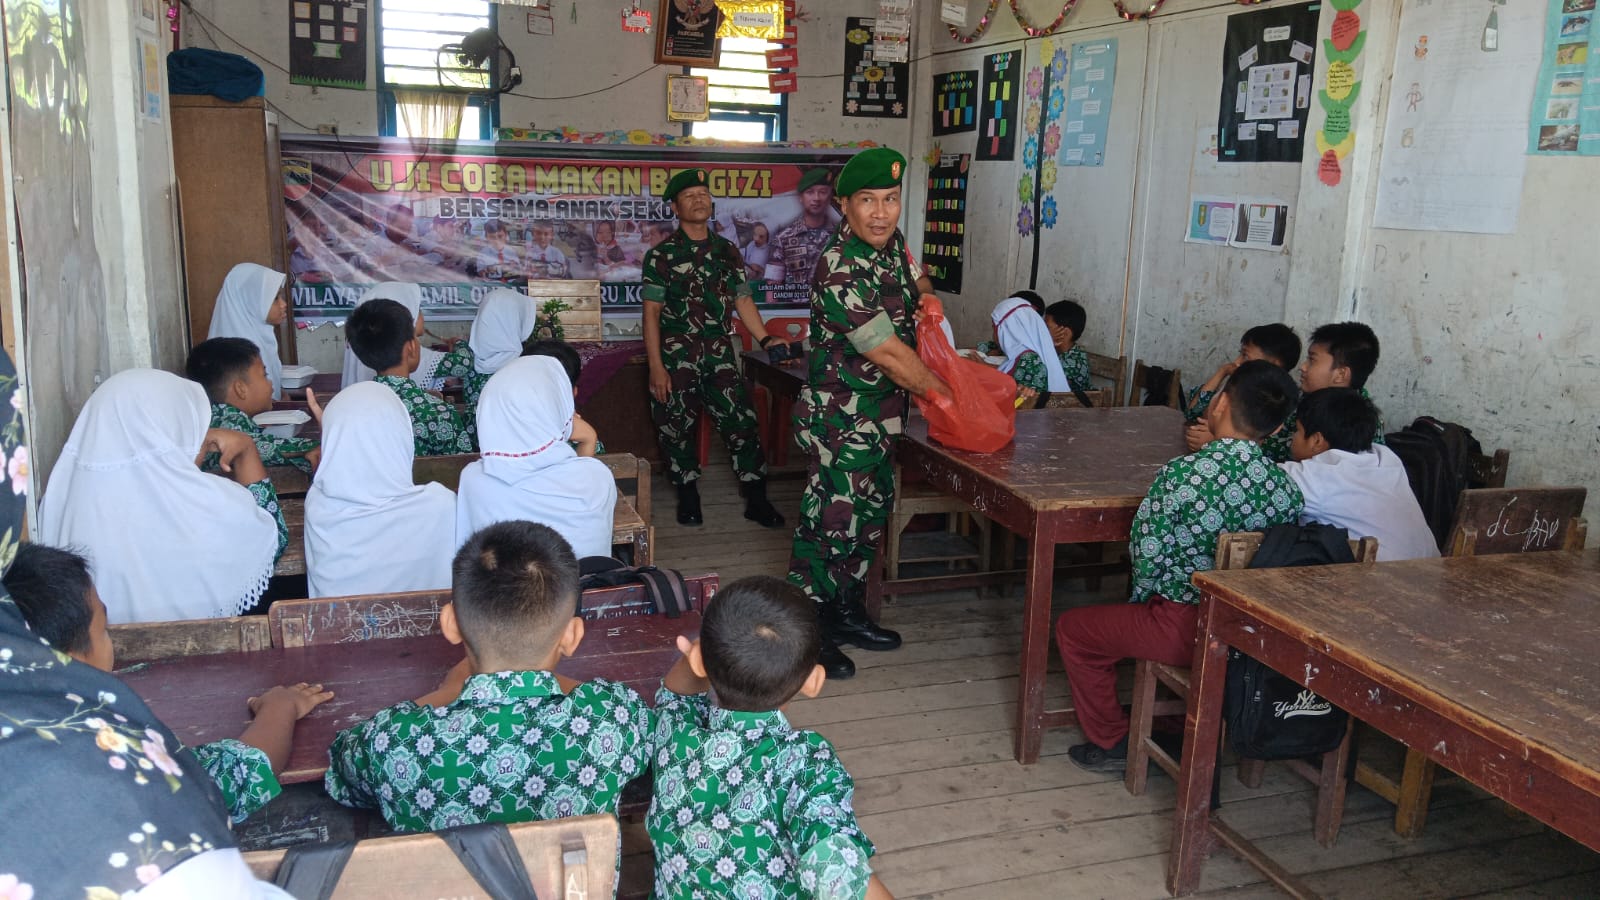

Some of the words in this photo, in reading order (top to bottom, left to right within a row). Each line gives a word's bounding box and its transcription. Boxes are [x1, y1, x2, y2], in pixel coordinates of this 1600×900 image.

[370, 160, 431, 192] UJI
[440, 162, 528, 194] COBA
[535, 164, 641, 196] MAKAN
[650, 167, 773, 198] BGIZI
[439, 198, 551, 219] BERSAMA
[555, 199, 615, 221] ANAK
[618, 200, 717, 221] SEKO
[420, 286, 465, 305] AMIL
[1272, 700, 1332, 720] Yankees
